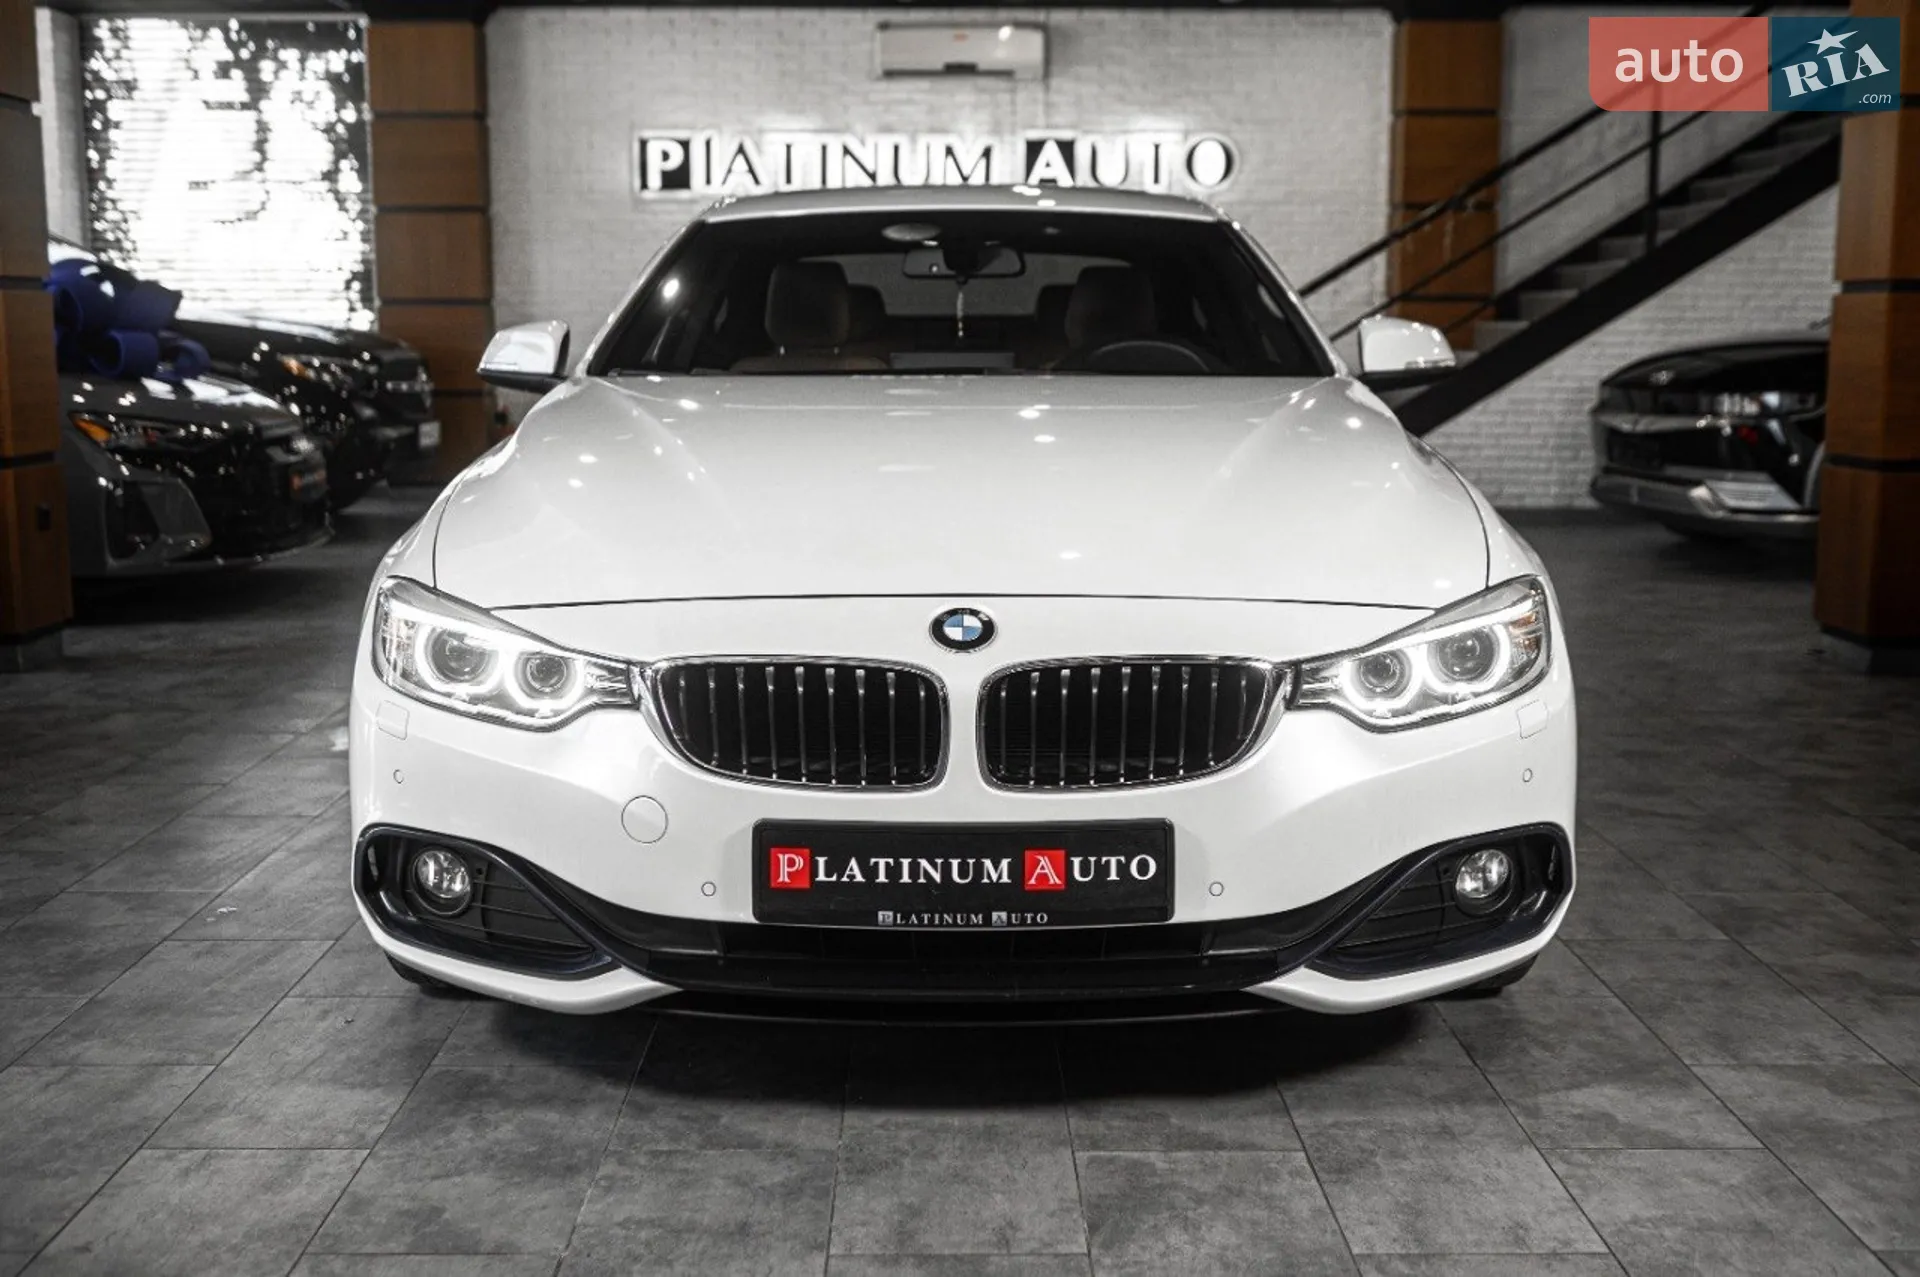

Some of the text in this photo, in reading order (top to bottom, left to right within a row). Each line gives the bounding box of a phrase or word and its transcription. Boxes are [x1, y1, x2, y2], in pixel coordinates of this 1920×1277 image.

[1026, 138, 1234, 188] AUTO
[772, 850, 1158, 887] PLATINUM AUTO
[878, 911, 1049, 926] PLATINUM AUTO
